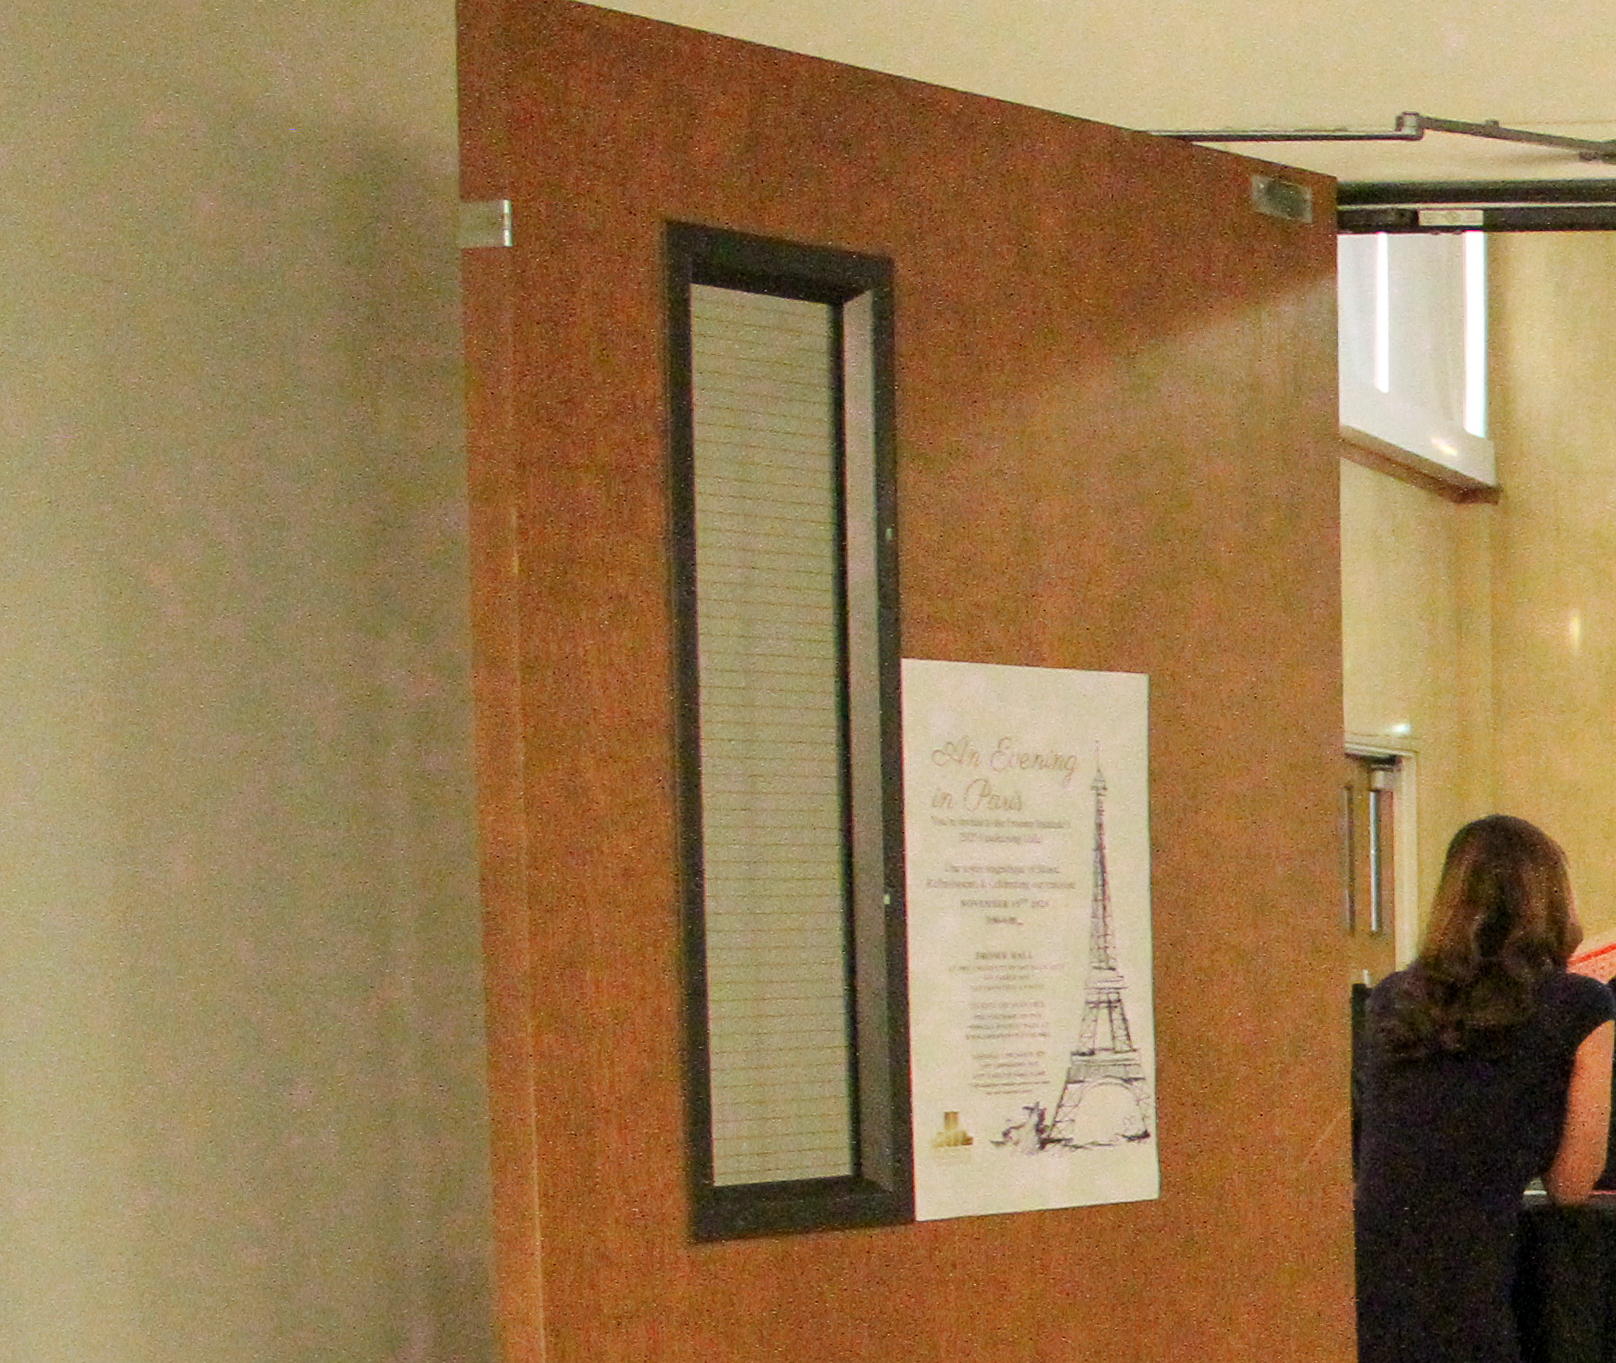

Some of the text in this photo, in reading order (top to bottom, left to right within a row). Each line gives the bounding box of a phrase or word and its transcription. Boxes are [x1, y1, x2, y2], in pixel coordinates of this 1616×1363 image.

[931, 735, 1078, 788] An Evening
[932, 778, 1023, 812] in Paris
